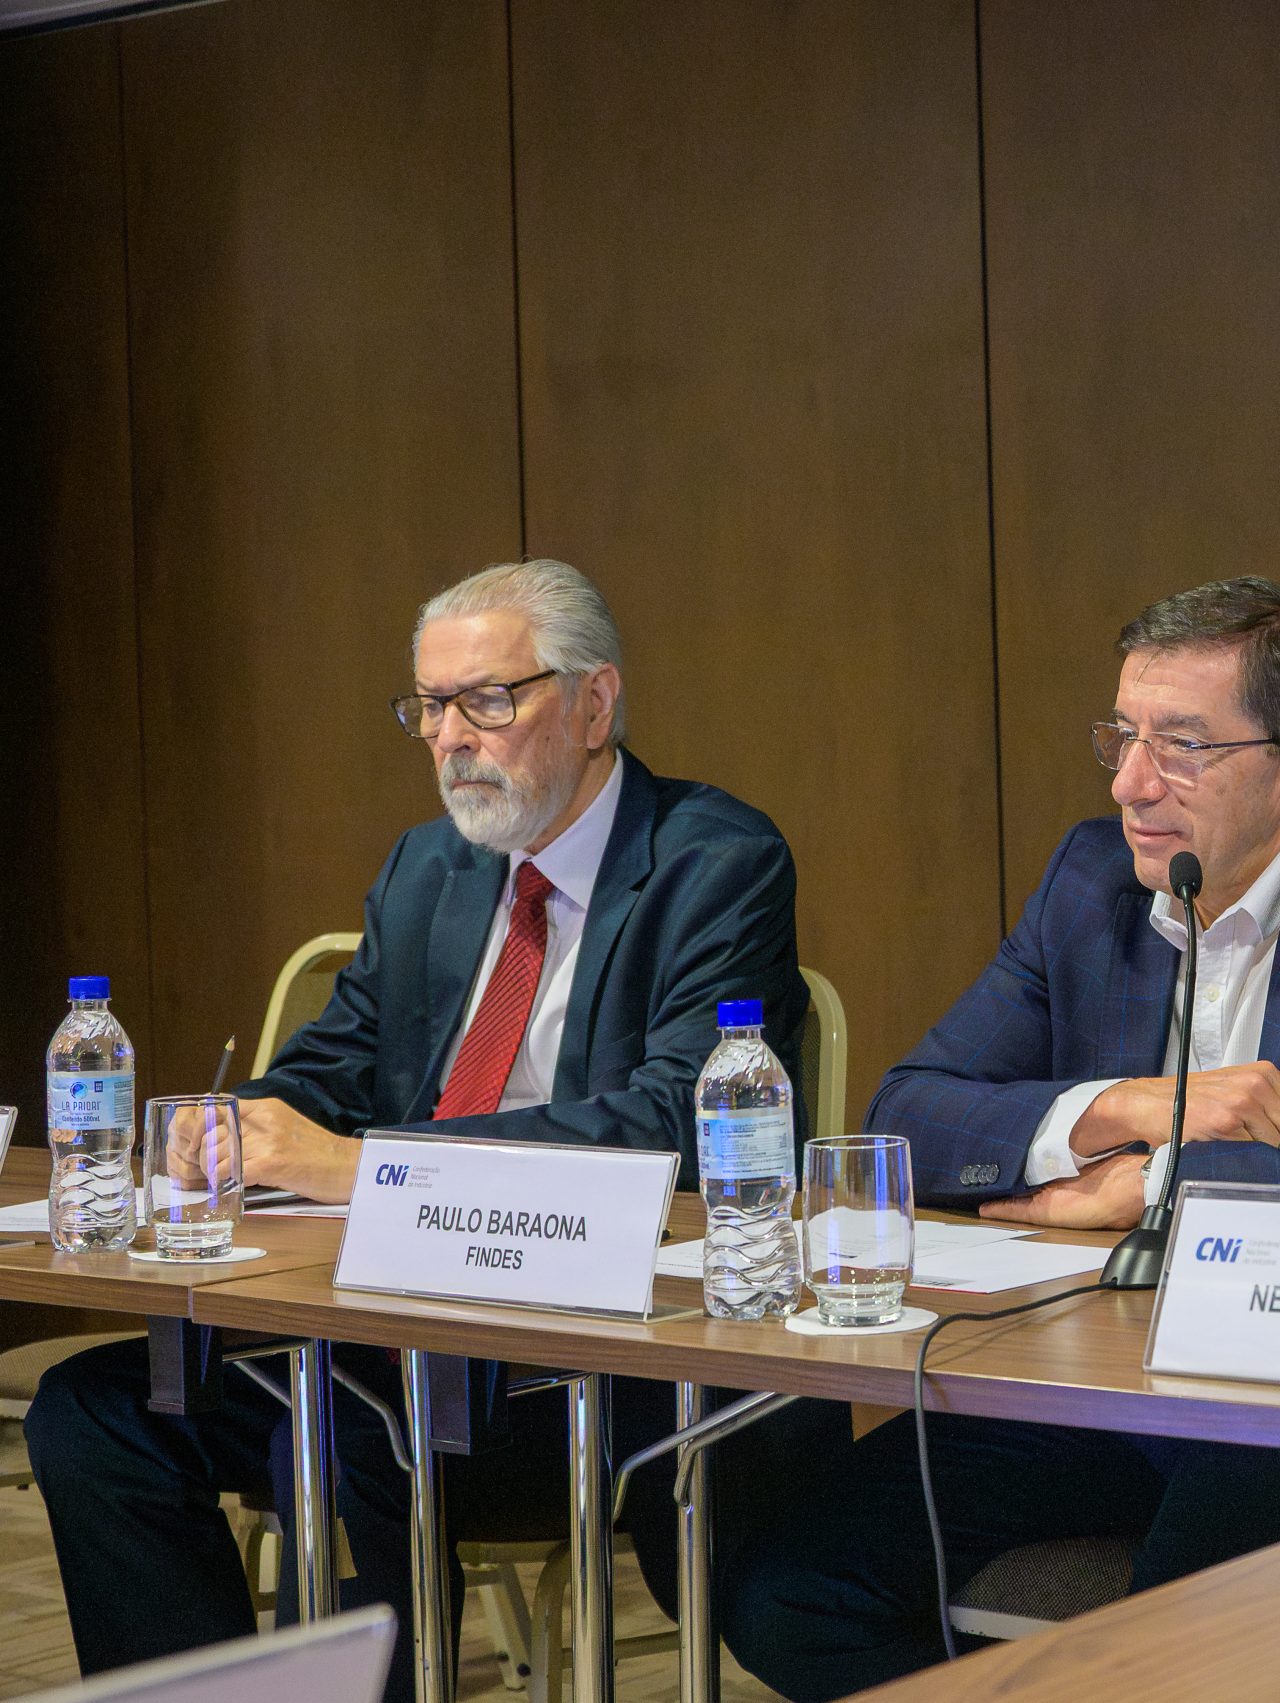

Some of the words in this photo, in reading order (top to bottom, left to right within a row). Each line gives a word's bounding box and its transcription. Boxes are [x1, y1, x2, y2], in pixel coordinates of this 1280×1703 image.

[416, 1204, 483, 1233] PAULO
[486, 1209, 587, 1242] BARAONA
[464, 1246, 524, 1270] FINDES
